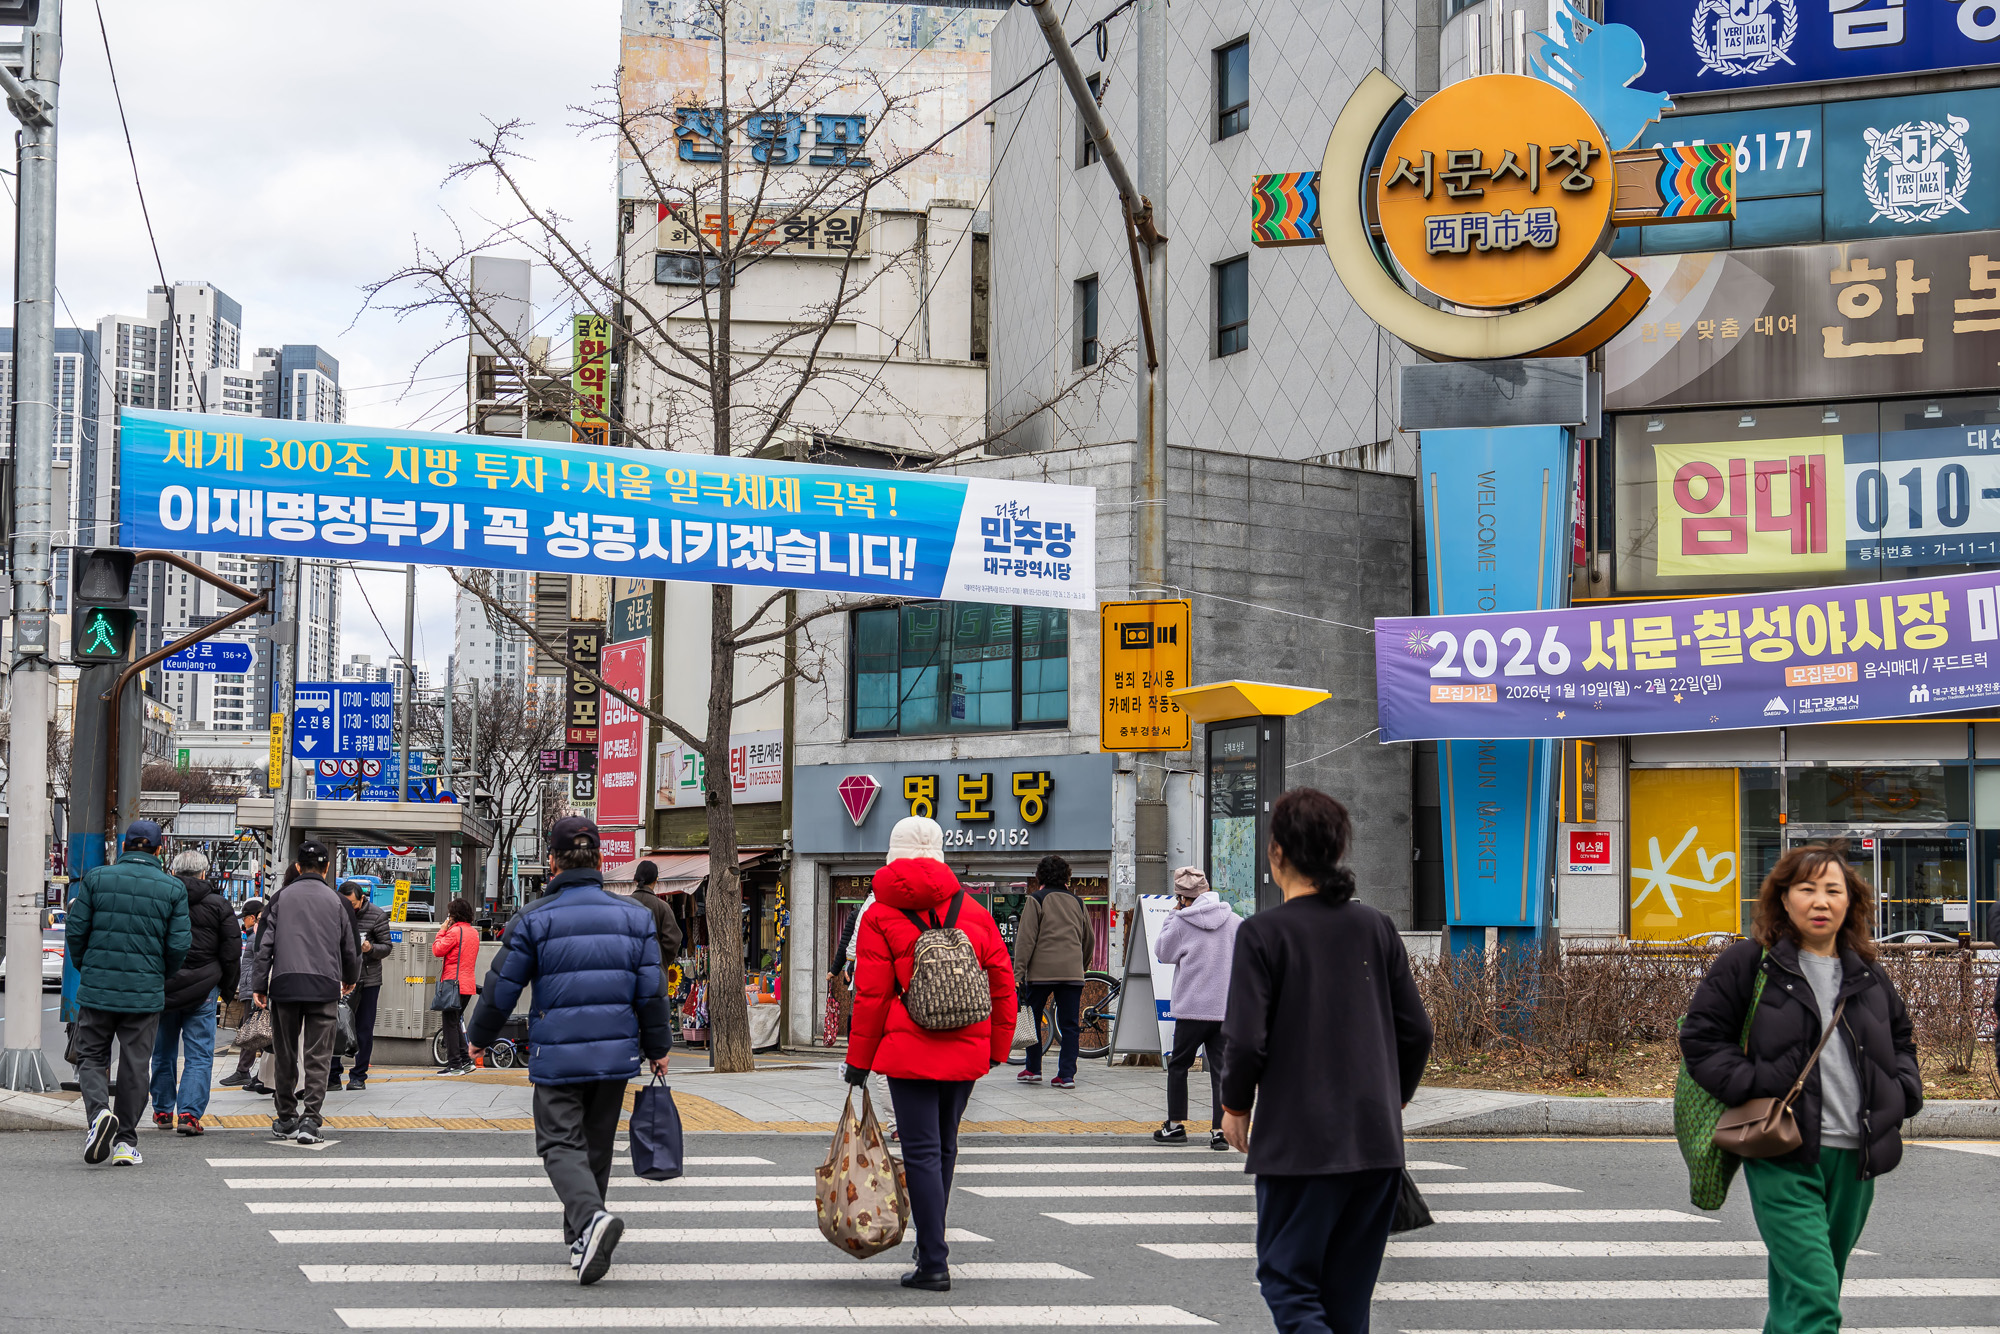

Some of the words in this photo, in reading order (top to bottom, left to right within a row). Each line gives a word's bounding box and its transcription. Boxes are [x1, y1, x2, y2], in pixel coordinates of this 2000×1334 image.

[1724, 26, 1742, 38] VERI
[1746, 26, 1765, 36] LUX
[1725, 37, 1742, 49] TAS
[1746, 35, 1767, 47] MEA
[1386, 139, 1601, 199] 서문시장
[1895, 173, 1914, 185] VERI
[1919, 173, 1939, 183] LUX
[1896, 184, 1914, 195] TAS
[1919, 182, 1940, 194] MEA
[1427, 212, 1559, 250] 西門市場
[1641, 320, 1684, 343] 한복
[1697, 316, 1740, 340] 맞춤
[1754, 312, 1798, 336] 대여
[163, 428, 244, 472] 재계
[259, 437, 371, 478] 300조
[384, 445, 462, 488] 지방
[474, 452, 548, 493] 투자
[581, 460, 653, 501] 서울
[664, 468, 802, 513] 일극체제
[813, 480, 878, 519] 극복
[994, 500, 1031, 521] 더불어
[1673, 453, 1828, 556] 임대
[1477, 470, 1497, 573] WELCOME
[159, 484, 470, 550] 이재명정부가
[483, 506, 529, 555] 꼭
[543, 510, 918, 582] 성공시키겠습니다!
[980, 516, 1077, 559] 민주당
[1858, 544, 1914, 561] 등록번호
[1933, 540, 2000, 557] 가-11-1
[983, 557, 1072, 582] 대구광역시당
[1477, 583, 1497, 612] TO
[1428, 625, 1572, 679] 2026
[1581, 591, 1951, 672] 서문·칠성야시장
[169, 643, 214, 659] 장로
[223, 651, 235, 659] 136
[166, 659, 217, 671] Keunjang-ro
[1791, 663, 1853, 684] 모집분야
[1863, 659, 1920, 679] 음식매대
[1931, 651, 1988, 672] 푸드트럭
[572, 634, 598, 725] 전당포
[1114, 670, 1135, 689] 범죄
[1142, 669, 1175, 689] 감시용
[1435, 685, 1493, 701] 모집기간
[1505, 683, 1552, 700] 2026년
[1555, 682, 1577, 699] 1월
[1580, 680, 1631, 698] 19일(월)
[1669, 673, 1722, 693] 22일(일)
[342, 691, 362, 707] 07:00
[370, 691, 390, 708] 09:00
[1109, 696, 1142, 714] 카메라
[1799, 694, 1860, 709] 대구광역시
[272, 716, 283, 725] CCTV
[298, 715, 331, 730] 스전용
[342, 713, 362, 729] 17:30
[371, 713, 390, 729] 19:30
[571, 729, 597, 742] 대부
[1119, 725, 1172, 737] 중부경찰서
[376, 734, 390, 752] 제외
[749, 742, 783, 765] 주문/제작
[903, 771, 1056, 826] 명보당
[943, 828, 1030, 847] 254-9152
[1478, 801, 1497, 884] MARKET
[1576, 841, 1604, 854] 에스원
[1569, 865, 1593, 873] SECOM
